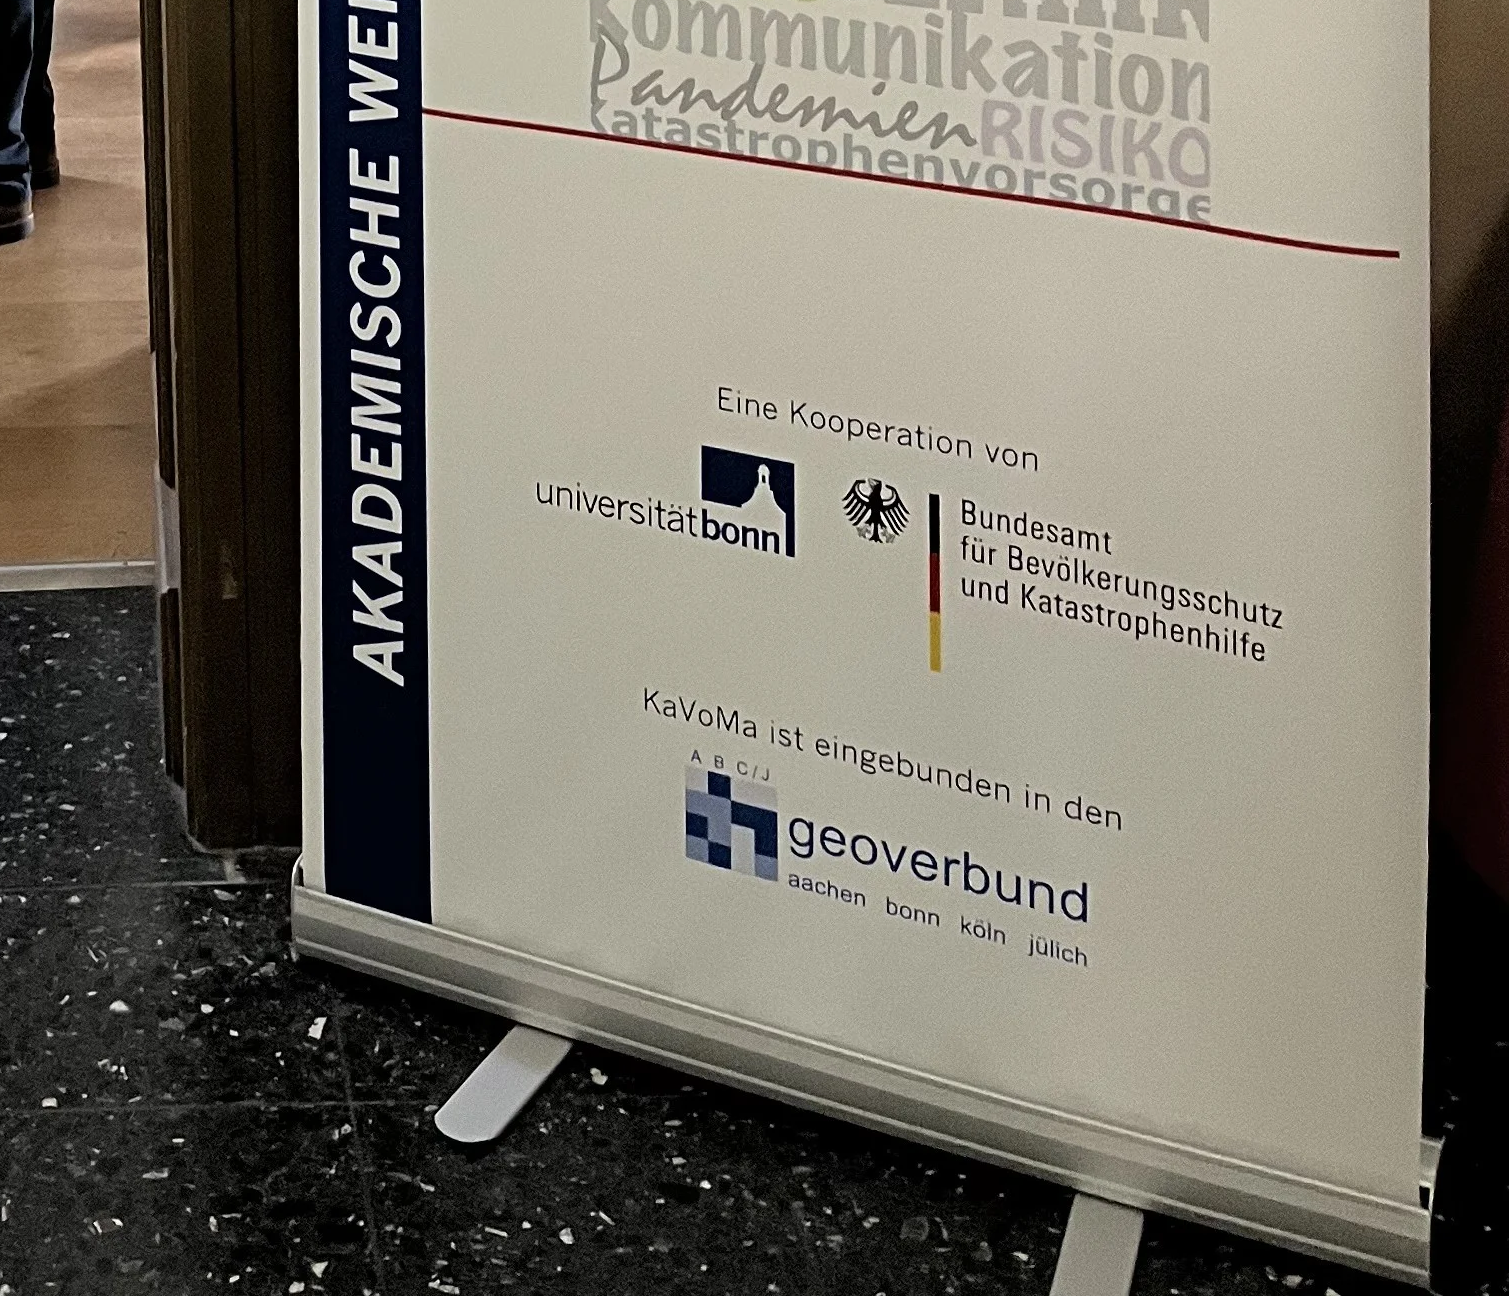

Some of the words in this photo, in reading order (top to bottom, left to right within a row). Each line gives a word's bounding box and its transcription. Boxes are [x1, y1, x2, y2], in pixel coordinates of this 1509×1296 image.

[591, 28, 978, 150] Pandemien
[981, 100, 1210, 188] RISIKO
[349, 147, 405, 687] AKADEMISCHE
[717, 386, 778, 421] Eine
[789, 401, 972, 460] Kooperation
[986, 445, 1039, 472] von
[961, 500, 1112, 555] Bundesamt
[961, 536, 997, 567] für
[1008, 546, 1284, 631] Bevölkerungsschutz
[961, 575, 1009, 605] und
[1020, 583, 1266, 662] Katastrophenhilfe
[643, 688, 757, 739] KaVoMa
[770, 720, 804, 751] ist
[815, 735, 1010, 803] eingebunden
[1025, 784, 1050, 813] in
[1065, 796, 1123, 830] den
[789, 816, 1089, 922] geoverbund
[788, 873, 866, 907] aachen
[886, 898, 940, 927] bonn
[960, 916, 1006, 944] köln
[1028, 934, 1088, 966] jülich
